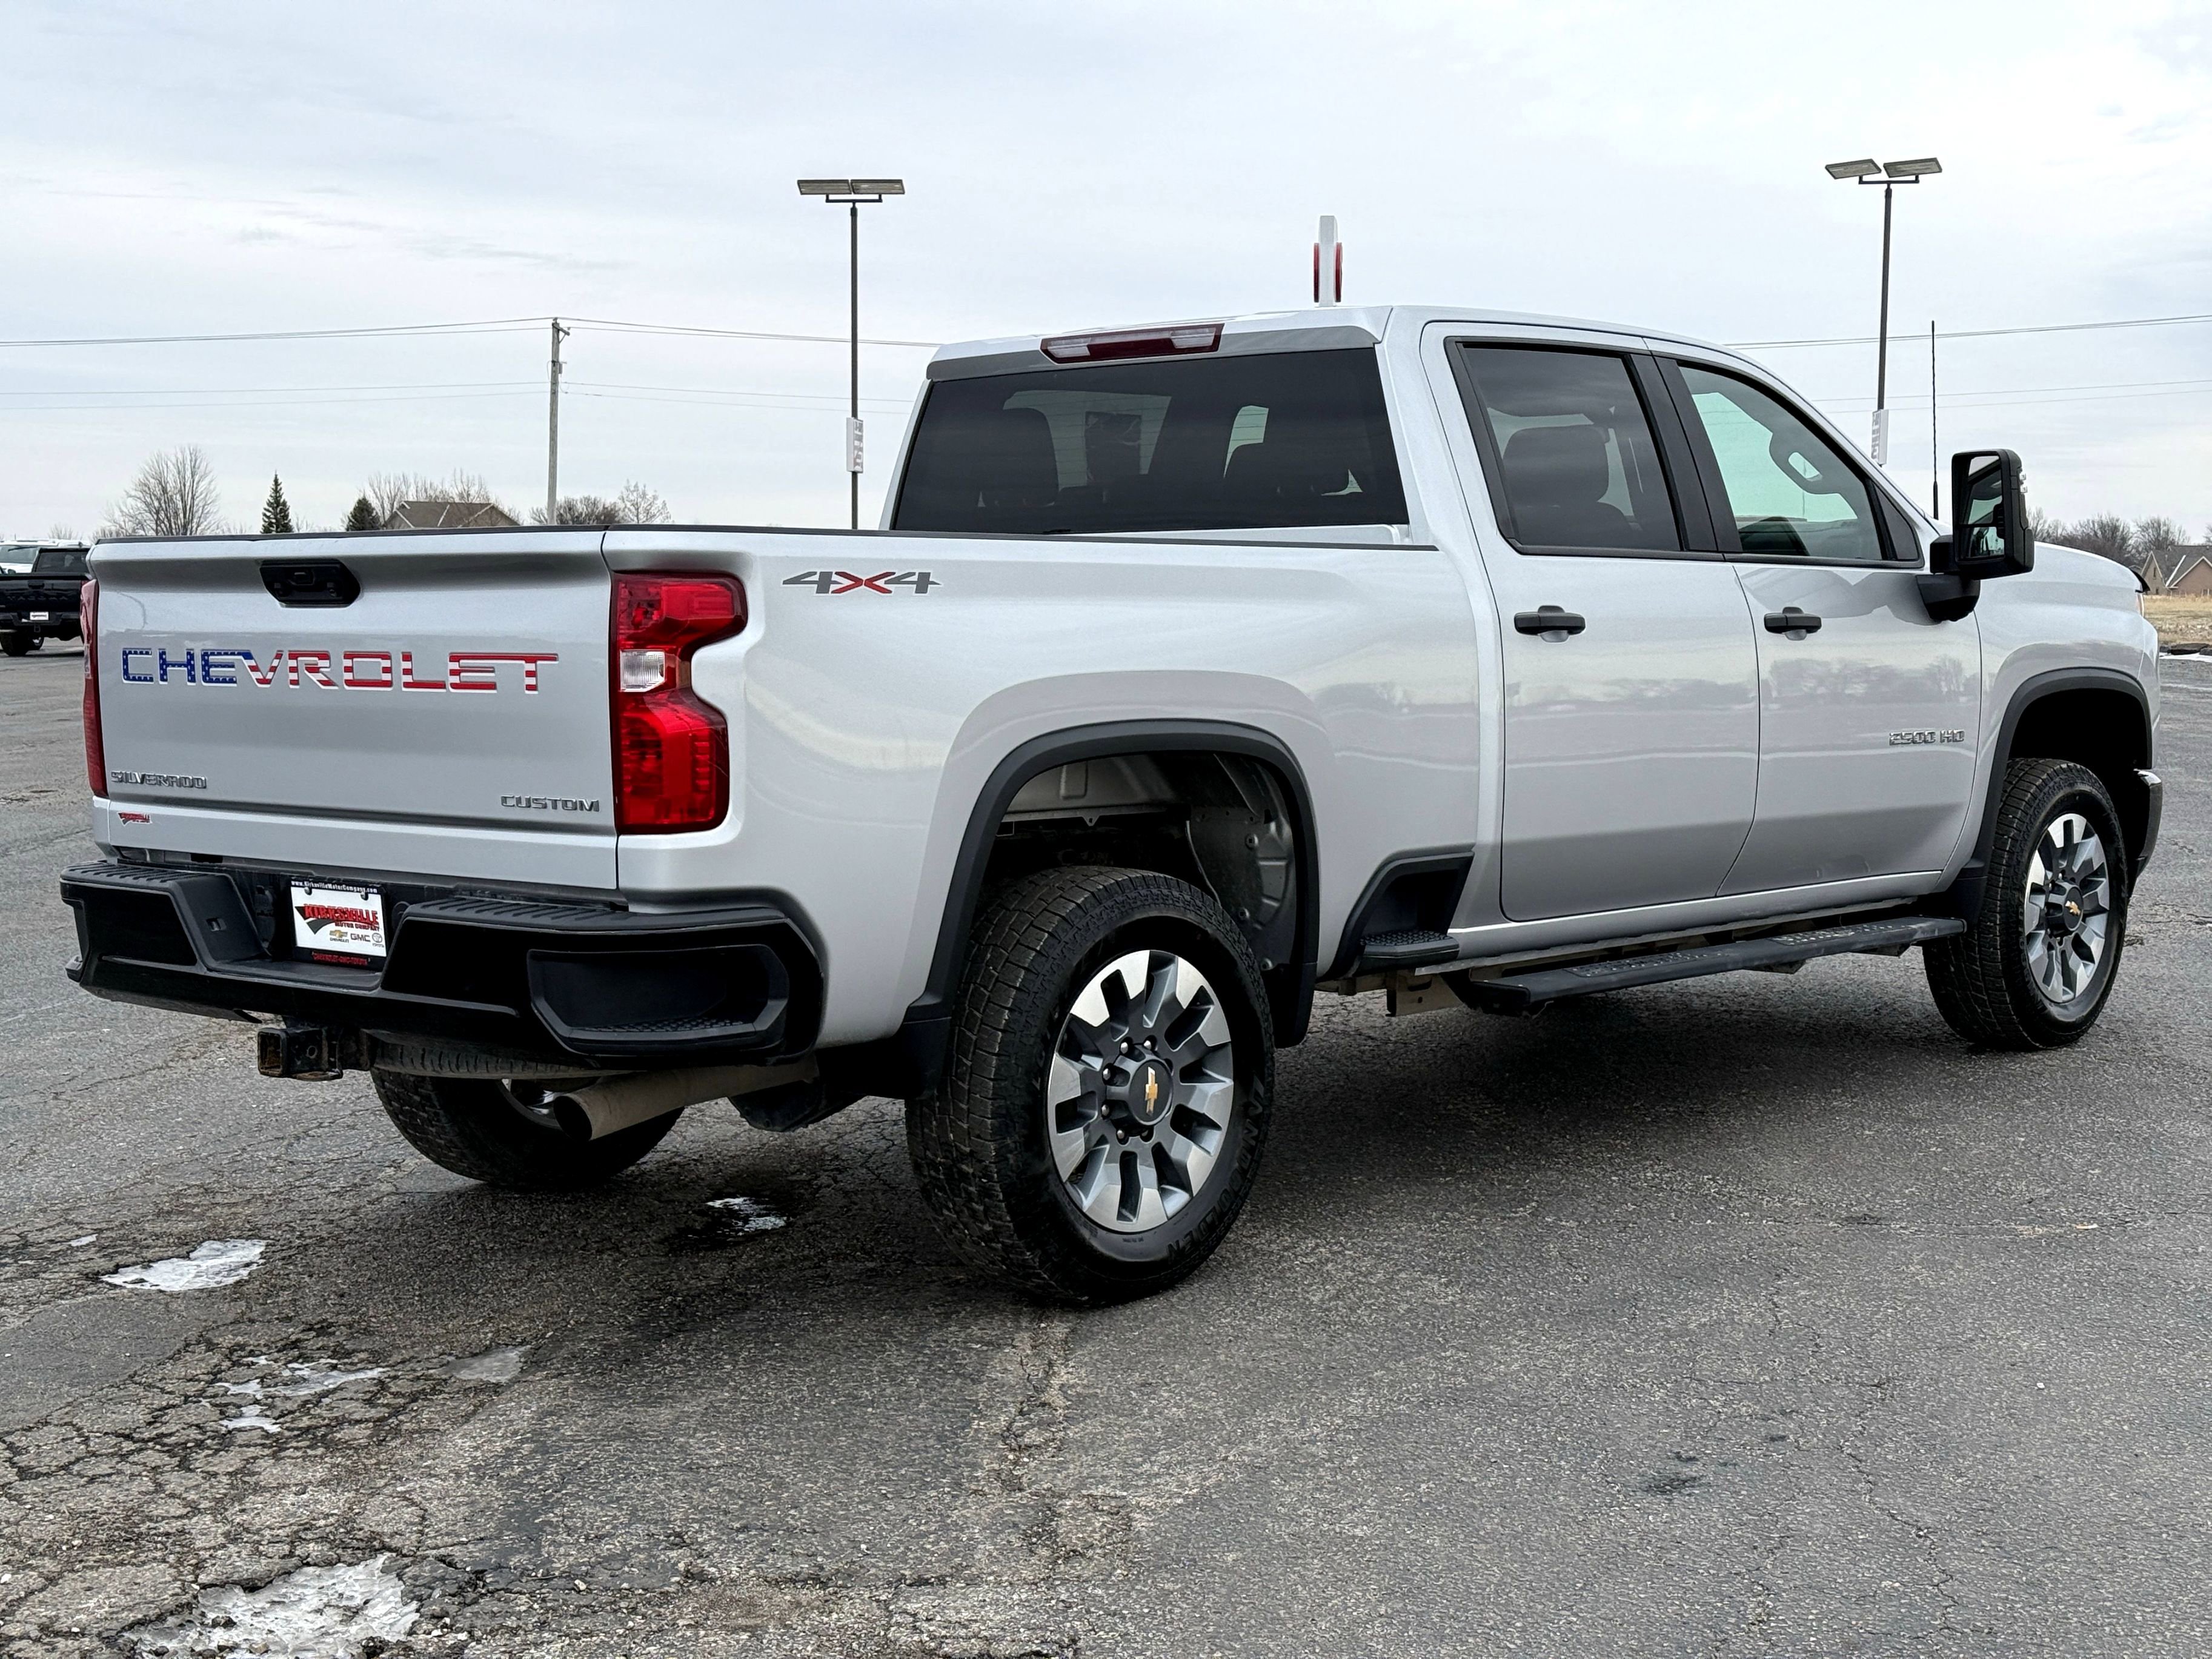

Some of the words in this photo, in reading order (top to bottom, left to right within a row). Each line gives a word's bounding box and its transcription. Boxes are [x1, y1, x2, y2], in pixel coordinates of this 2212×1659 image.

[122, 648, 559, 694] CHEVROLET
[1889, 731, 1936, 746] 2500
[1940, 729, 1965, 743] HD
[111, 770, 207, 789] SILVERADO
[500, 794, 600, 813] CUSTOM
[291, 880, 377, 893] www.KirksvilleMotorCompany.com
[304, 903, 379, 926] KIRKSVILLE
[350, 933, 371, 942] GMC
